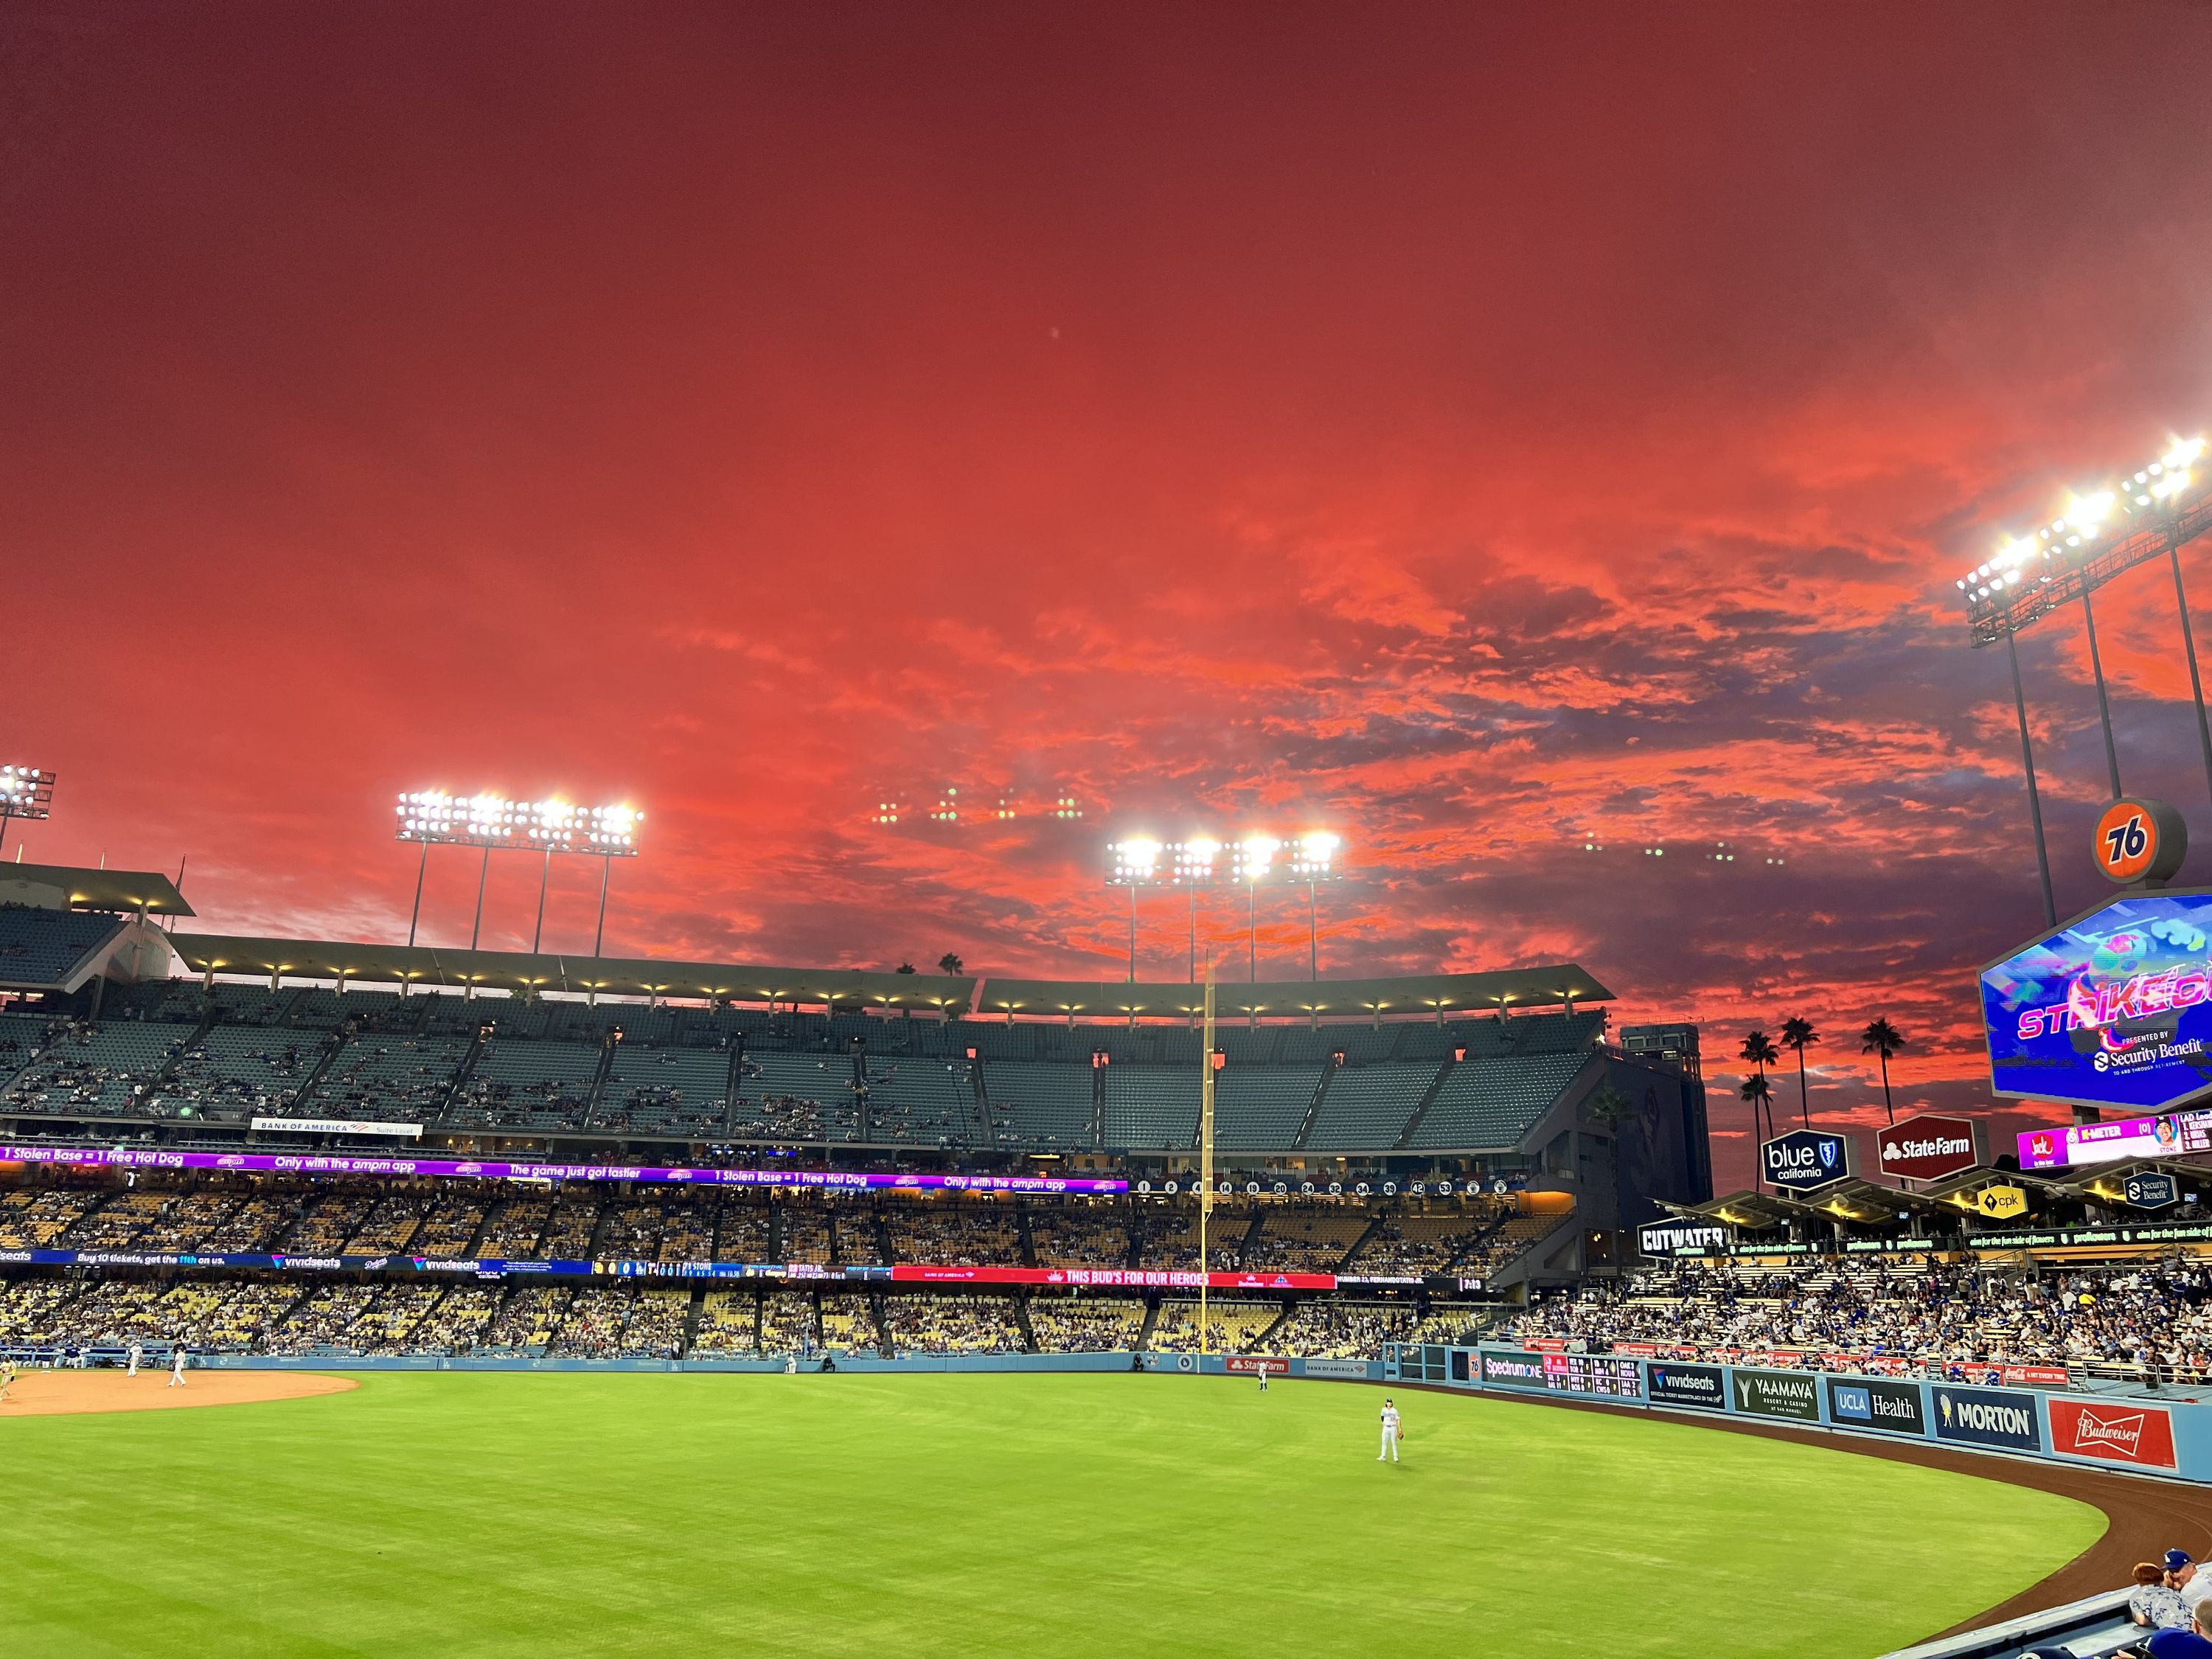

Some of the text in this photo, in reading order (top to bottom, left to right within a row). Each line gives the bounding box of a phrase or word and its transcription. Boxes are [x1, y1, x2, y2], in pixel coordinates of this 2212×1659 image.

[2106, 815, 2146, 865] 76
[2122, 1032, 2158, 1045] PRESENTED
[2110, 1039, 2202, 1067] Security Benefit
[2132, 1065, 2153, 1074] THROUGH
[2180, 1113, 2194, 1122] LAD
[2081, 1126, 2121, 1140] K-METER
[2031, 1136, 2053, 1155] Jack
[4, 1148, 183, 1166] 1 Stolen Base 1 Free Hot Dog
[1768, 1144, 1815, 1169] blue
[275, 1156, 416, 1173] Only with the ampm app
[510, 1164, 641, 1180] The game just got faster
[715, 1170, 867, 1186] 1 Stolen Base 1 Free Hot Dog
[1778, 1167, 1822, 1180] california
[944, 1176, 1066, 1191] Only with the ampm app
[1222, 1184, 1230, 1192] 14
[1276, 1185, 1285, 1193] 20
[1303, 1185, 1312, 1193] 24
[1330, 1185, 1340, 1193] 32
[1357, 1185, 1368, 1193] 34
[1385, 1184, 1394, 1192] 39
[1413, 1183, 1423, 1192] 42
[1440, 1183, 1450, 1192] 53
[2141, 1180, 2168, 1192] Security
[2143, 1189, 2166, 1200] Benefit
[1999, 1197, 2018, 1209] cpk
[2137, 1226, 2208, 1239] aim for the fun side of
[1643, 1228, 1723, 1251] CUTWATER
[1982, 1237, 1991, 1247] for
[2002, 1237, 2011, 1246] fun
[2012, 1236, 2025, 1244] side
[2025, 1235, 2032, 1245] of
[2032, 1235, 2054, 1245] flowers
[77, 1253, 96, 1263] Buy
[97, 1253, 108, 1262] 10
[110, 1254, 144, 1264] tickets,
[145, 1255, 161, 1265] get
[162, 1255, 177, 1263] the
[179, 1255, 196, 1264] 11th
[285, 1256, 340, 1268] vividseats
[364, 1256, 388, 1269] Dodgers
[425, 1259, 479, 1270] vividseats
[608, 1262, 616, 1274] 0
[623, 1262, 630, 1274] 0
[693, 1262, 712, 1270] STONE
[1067, 1270, 1208, 1286] THIS BUD'S FOR OUR HEROES
[1244, 1360, 1284, 1371] StatFarm
[1470, 1359, 1479, 1373] 76
[1666, 1373, 1714, 1391] vividseats
[1755, 1378, 1813, 1399] YAAMAVA'
[1839, 1393, 1916, 1419] UCLA Health
[1958, 1402, 2029, 1436] MORTON
[2078, 1418, 2140, 1441] Budweiser
